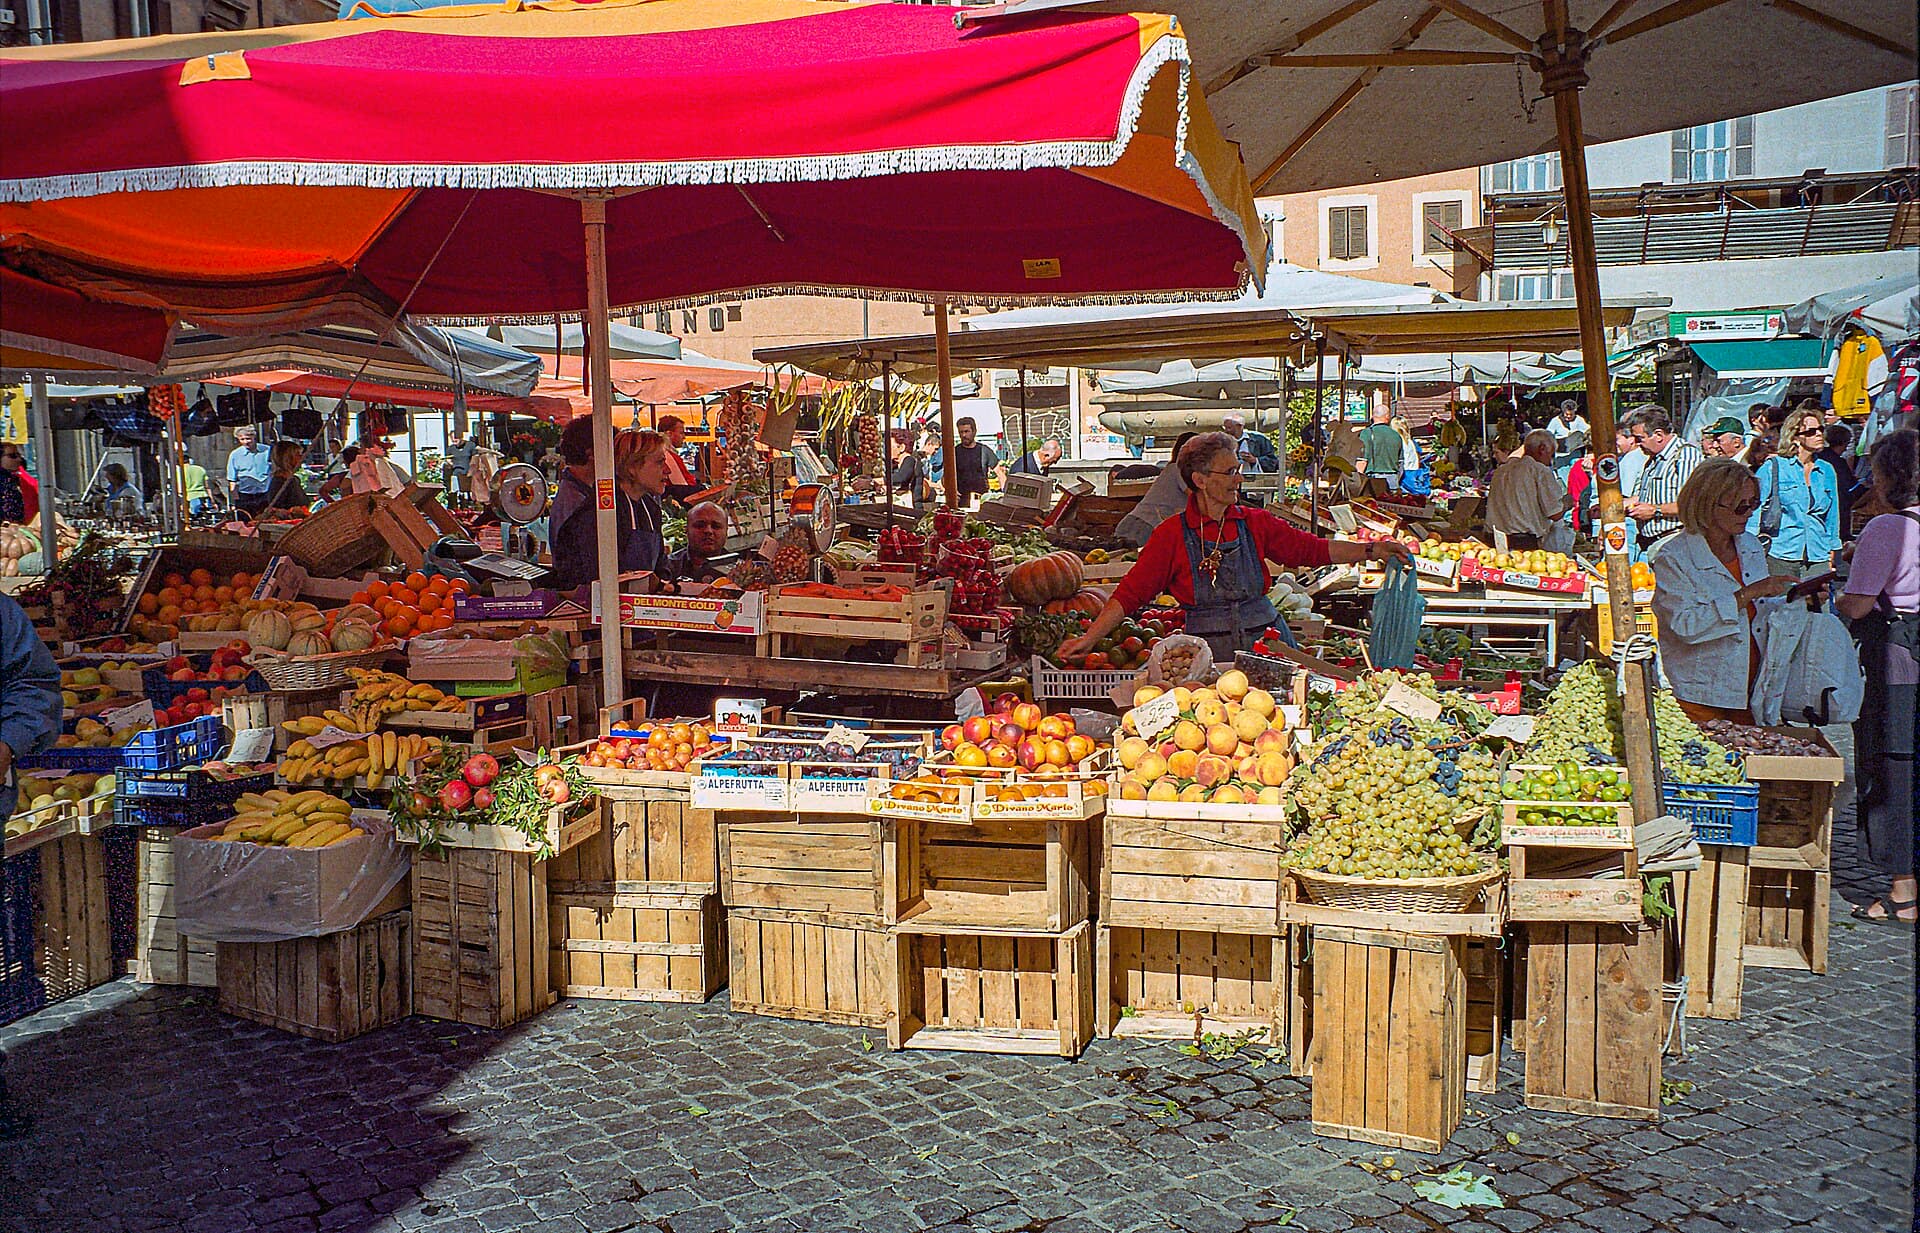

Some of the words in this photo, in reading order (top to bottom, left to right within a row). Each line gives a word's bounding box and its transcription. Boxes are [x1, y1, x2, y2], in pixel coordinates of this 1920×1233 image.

[634, 597, 652, 606] DEL
[652, 599, 687, 608] MONTE
[689, 601, 716, 610] GOLD
[721, 711, 757, 725] ROMA
[708, 779, 764, 790] ALPEFRUTTA
[808, 781, 866, 793] ALPEFRUTTA
[884, 800, 925, 812] Divano
[991, 803, 1034, 813] Divano
